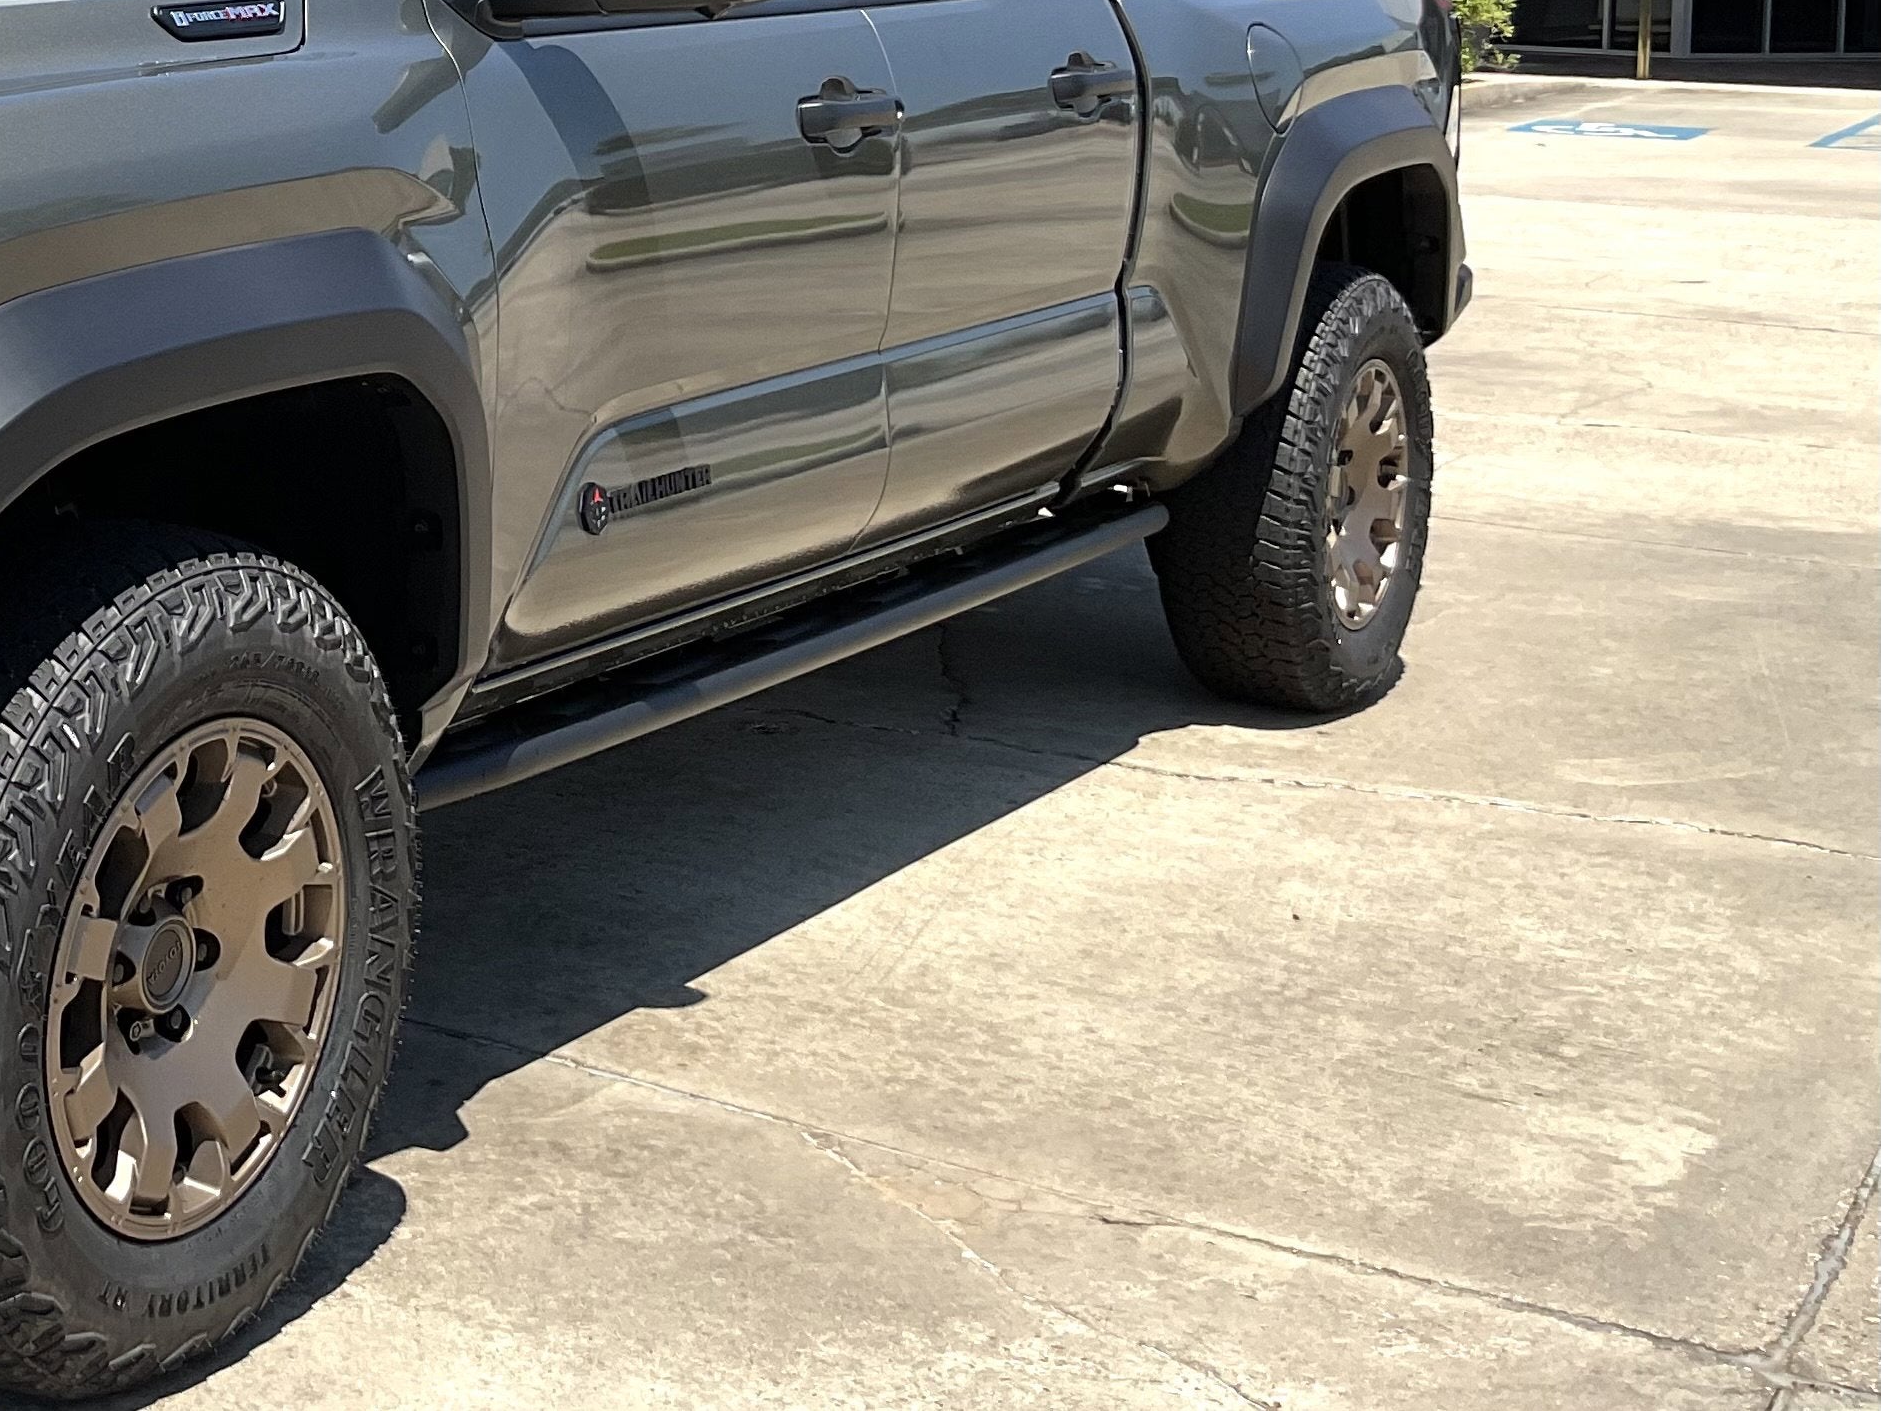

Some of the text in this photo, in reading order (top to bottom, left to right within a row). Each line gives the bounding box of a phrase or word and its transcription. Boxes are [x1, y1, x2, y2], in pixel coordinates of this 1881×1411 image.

[608, 464, 712, 513] TRAILHUNTER
[301, 764, 399, 1182] WRANGLER
[142, 1243, 269, 1318] TERRITORY
